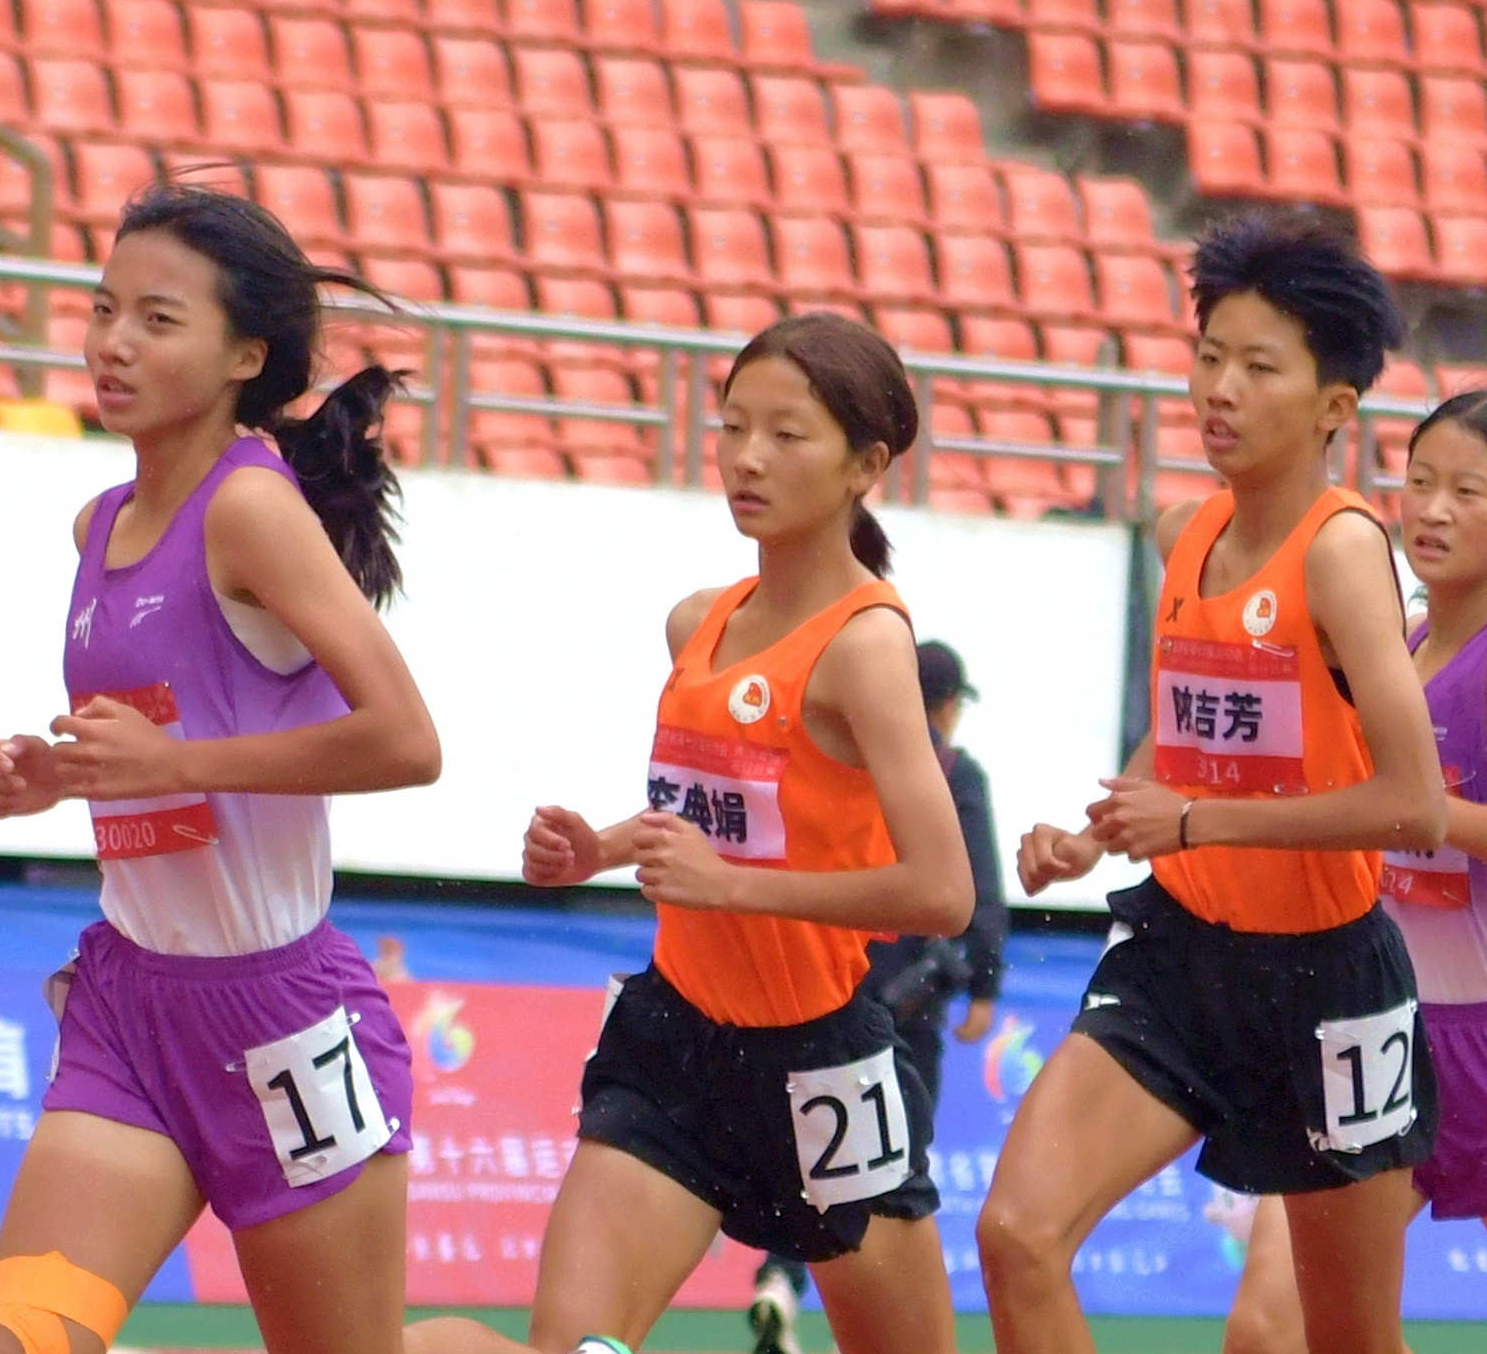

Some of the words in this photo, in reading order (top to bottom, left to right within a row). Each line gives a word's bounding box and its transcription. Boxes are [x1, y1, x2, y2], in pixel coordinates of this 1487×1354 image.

[267, 1036, 366, 1161] 17
[1336, 1032, 1410, 1126] 12
[800, 1081, 903, 1181] 21
